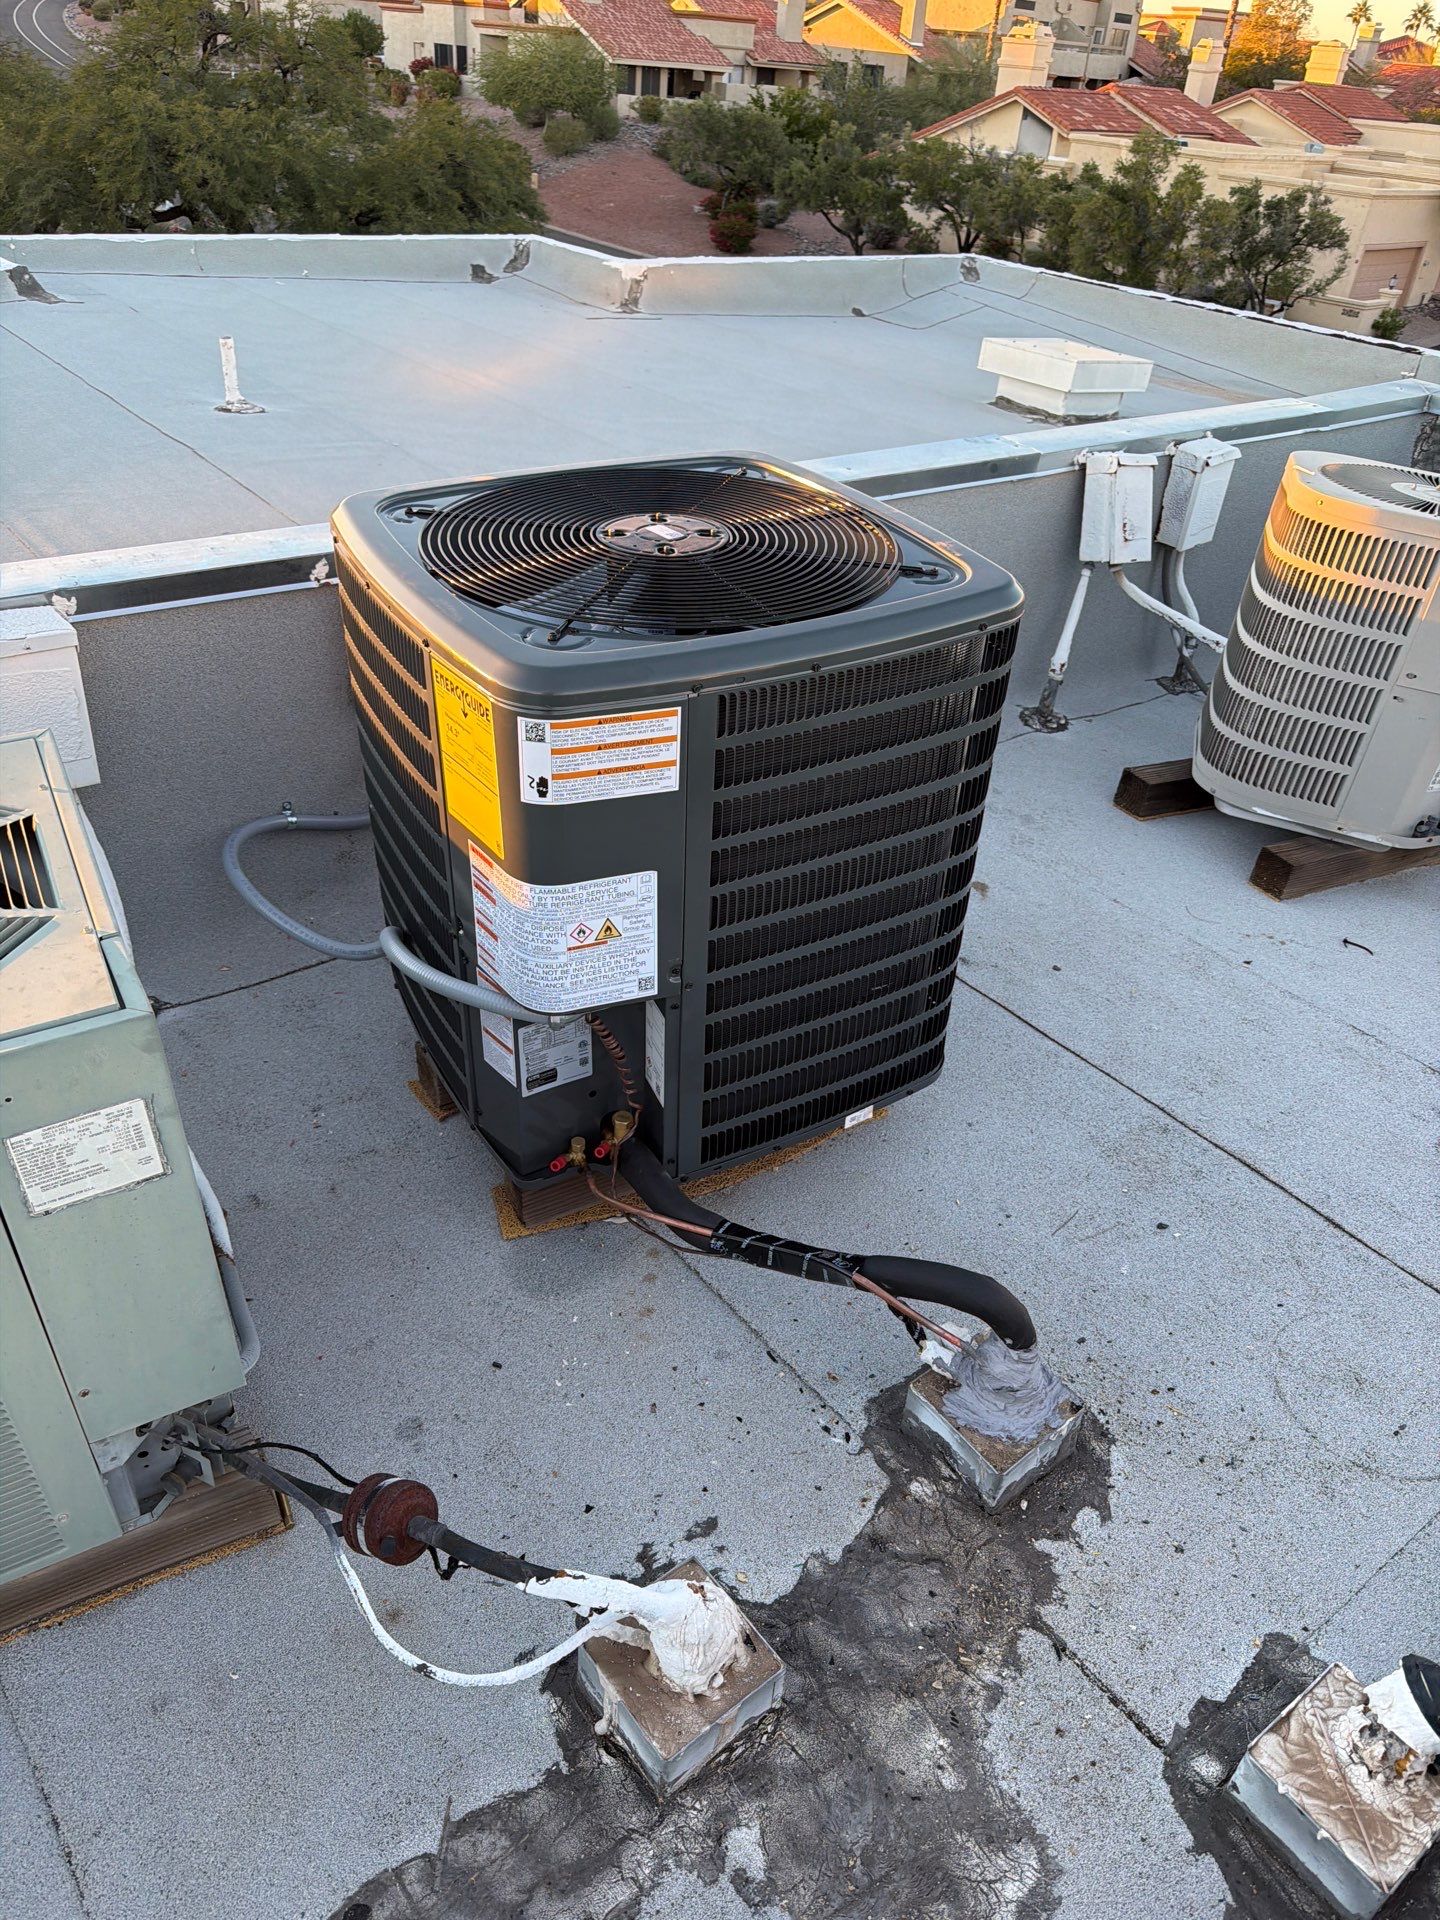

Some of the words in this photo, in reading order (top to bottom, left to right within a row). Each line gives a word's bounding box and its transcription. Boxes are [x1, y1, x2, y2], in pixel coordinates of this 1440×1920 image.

[602, 715, 632, 724] WARNING
[602, 764, 646, 774] ADVERTENCIA
[530, 886, 576, 895] FLAMMABLE
[579, 877, 631, 891] REFRIGERANT
[551, 892, 584, 902] TRAINED
[586, 886, 618, 897] SERVICE
[551, 895, 604, 909] REFRIGERANT
[531, 924, 564, 932] DISPOSE
[546, 931, 566, 939] WITH
[575, 956, 606, 967] DEVICES
[609, 951, 634, 960] WHICH
[635, 948, 650, 956] MAY
[531, 973, 568, 981] AUXILIARY
[571, 969, 602, 980] DEVICES
[604, 964, 629, 974] LISTED
[631, 961, 646, 969] FOR
[573, 961, 612, 973] INSTALLED
[570, 979, 584, 987] SEE
